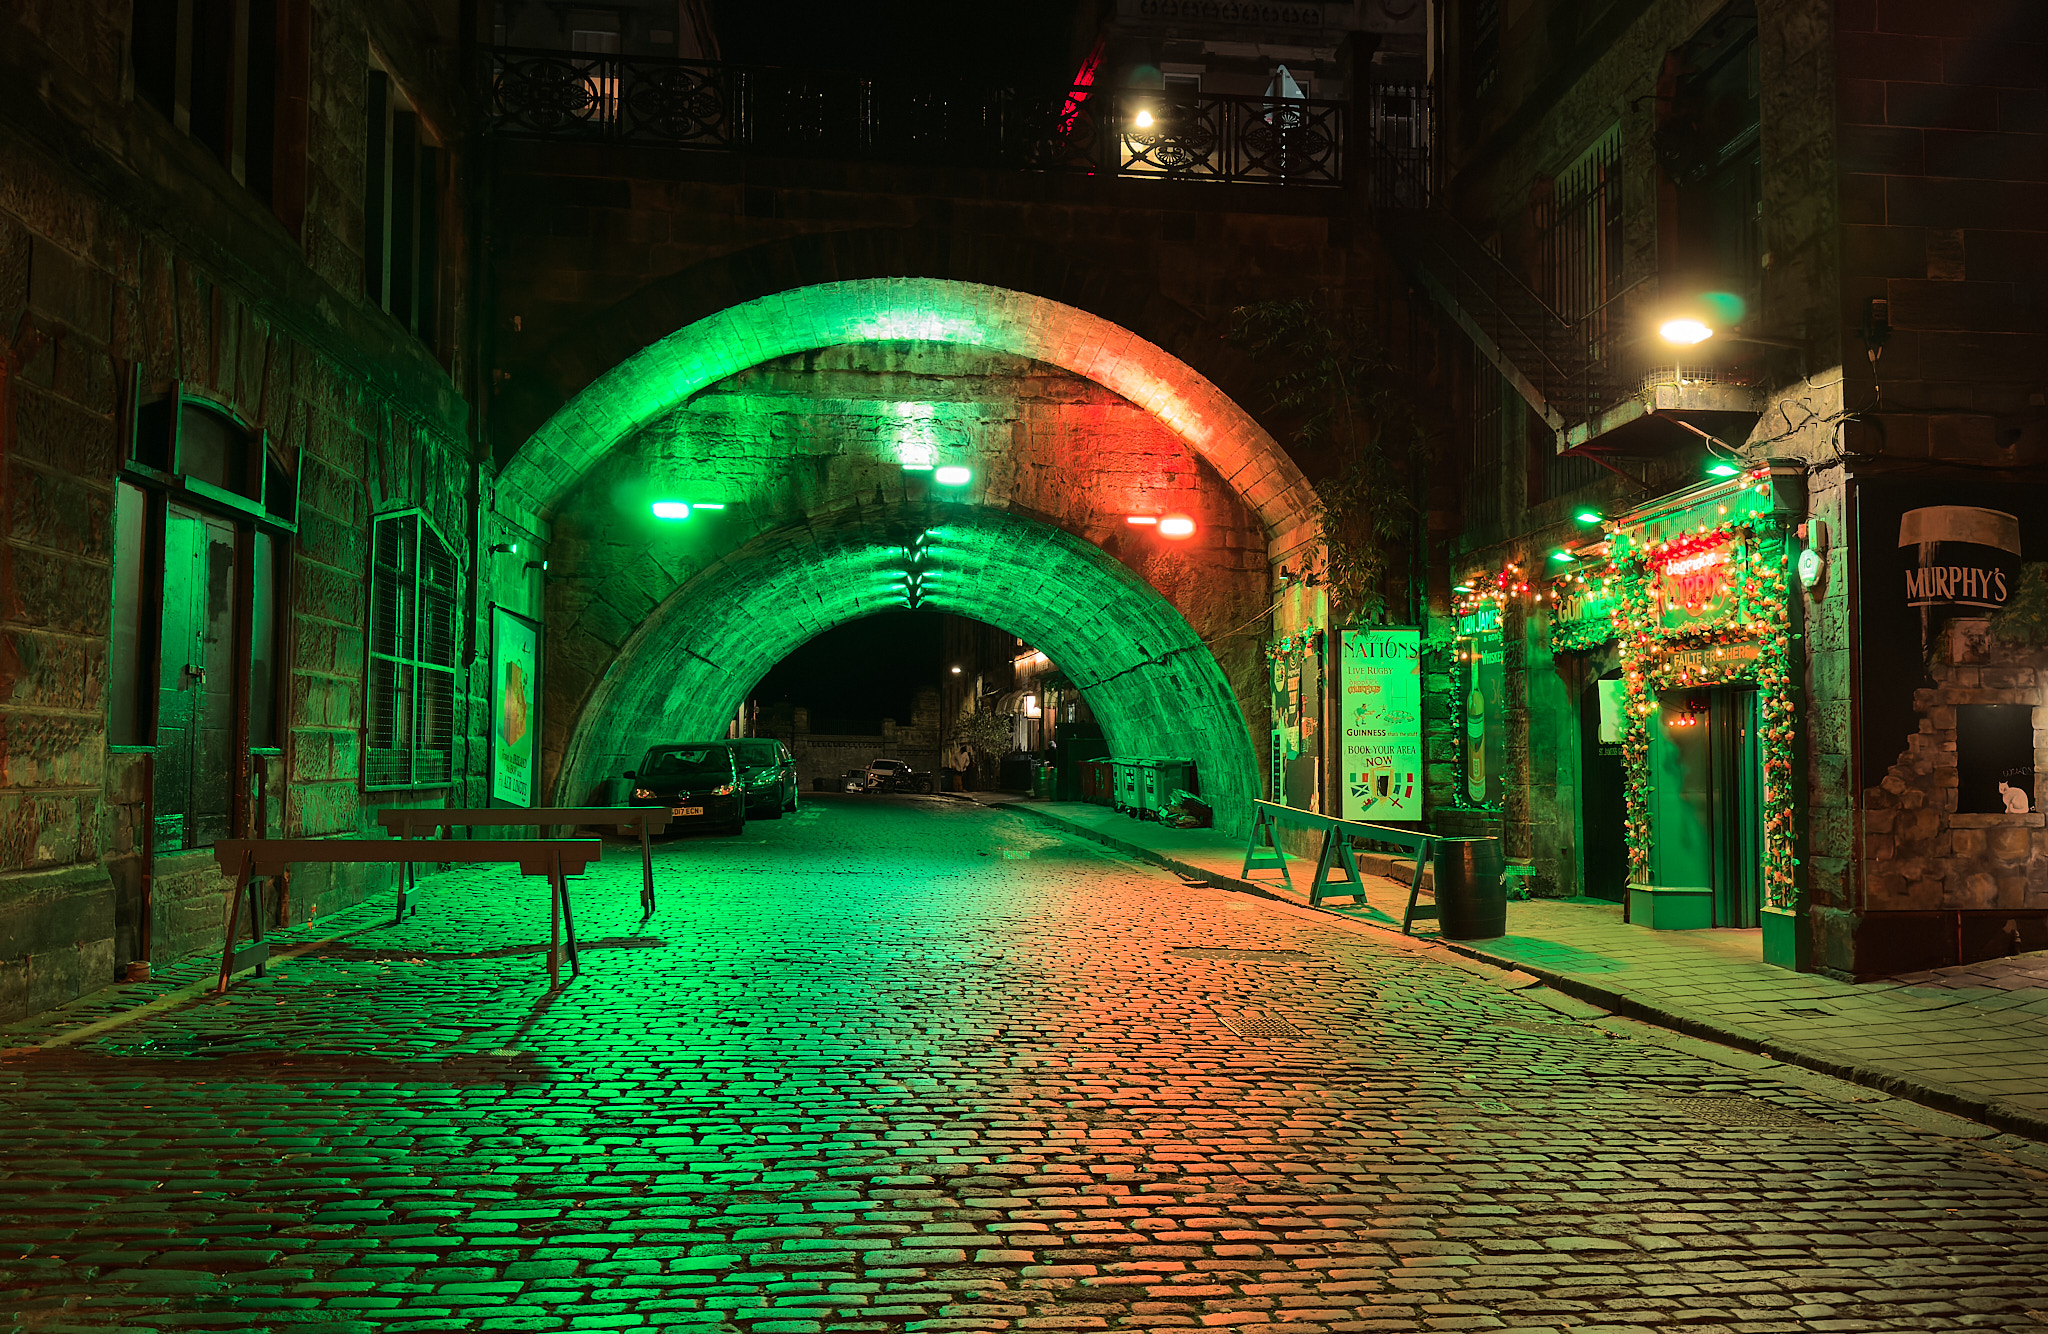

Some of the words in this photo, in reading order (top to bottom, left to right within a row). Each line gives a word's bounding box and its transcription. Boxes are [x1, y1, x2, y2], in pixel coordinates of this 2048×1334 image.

[1905, 566, 2008, 602] MURPHY'S
[1458, 613, 1476, 636] JOHN
[1348, 666, 1364, 675] LIVE
[1367, 666, 1394, 675] RUGBY
[1346, 728, 1387, 737] GUINNESS
[1348, 745, 1371, 755] BOOK
[1373, 745, 1395, 755] YOUR
[1396, 745, 1416, 755] AREA
[1365, 755, 1393, 768] NOW
